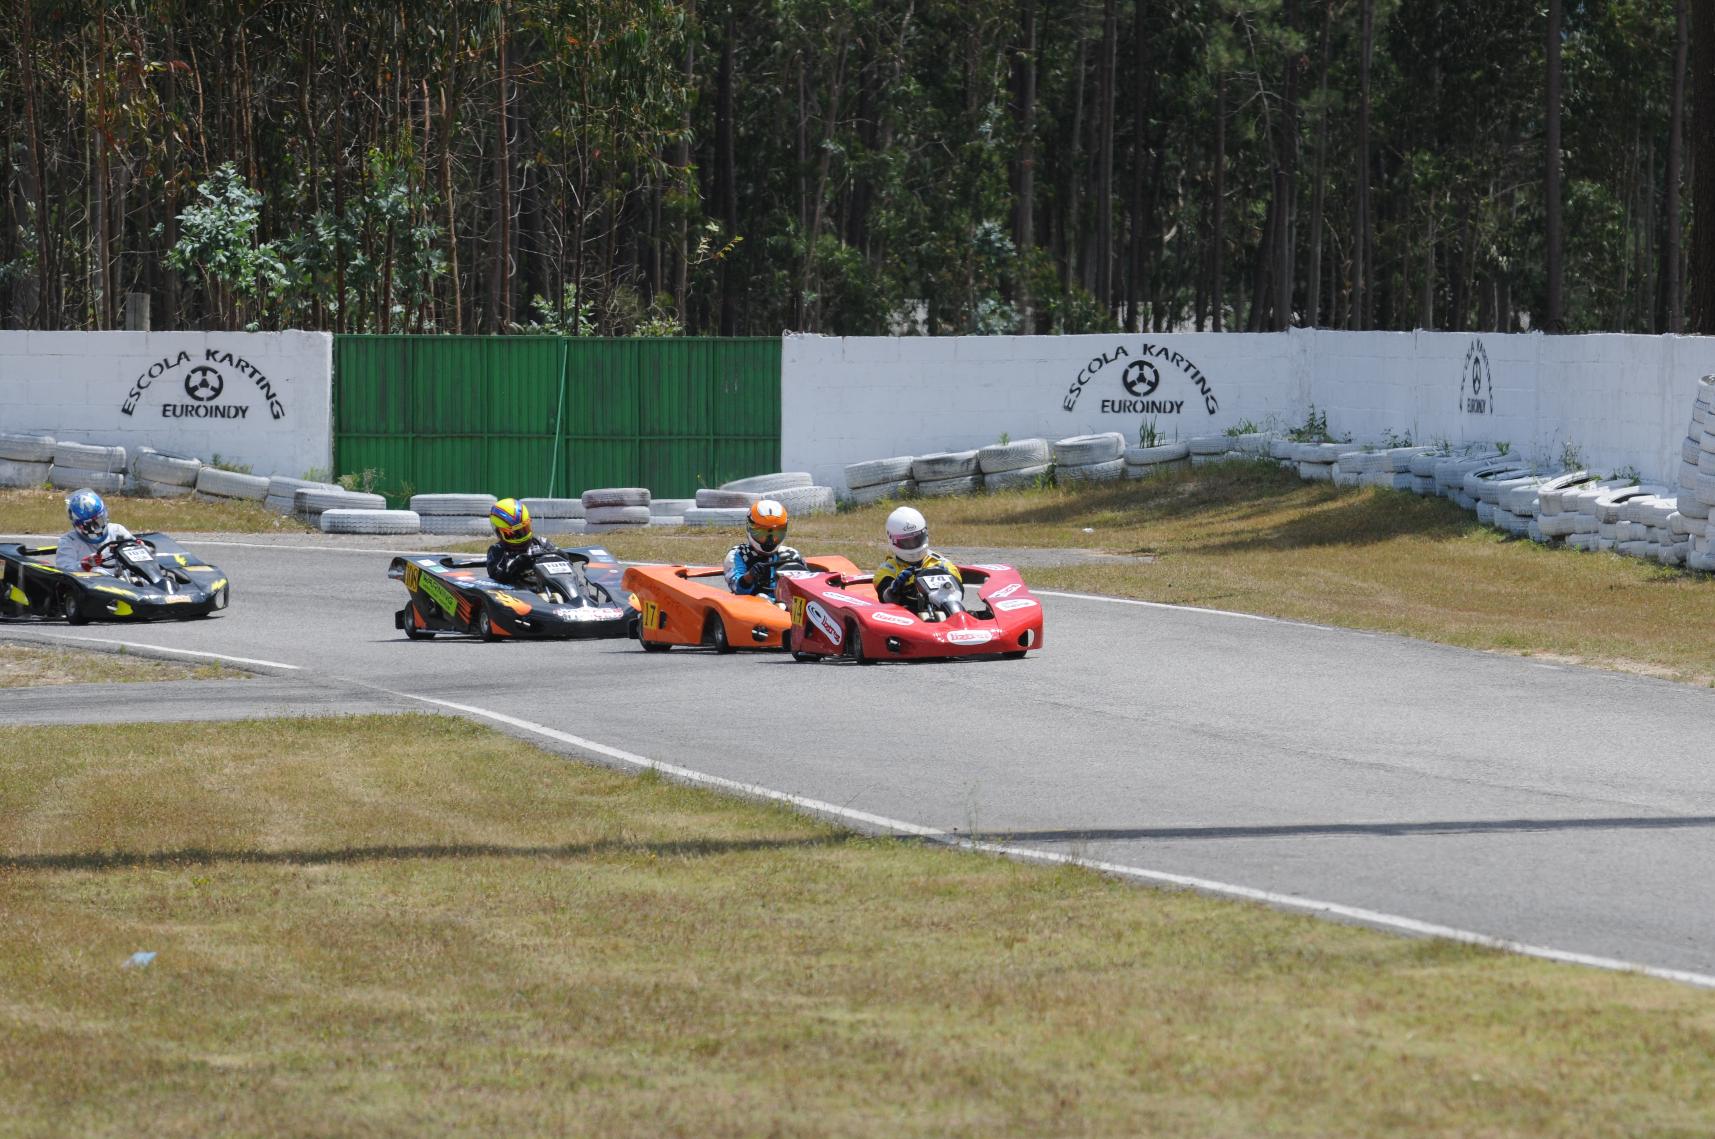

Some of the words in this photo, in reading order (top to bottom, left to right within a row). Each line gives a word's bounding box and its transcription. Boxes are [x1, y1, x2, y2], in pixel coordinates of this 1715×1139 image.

[121, 351, 191, 416] ESCOLA
[206, 349, 285, 420] KARTING
[1063, 346, 1129, 412] ESCOLA
[1143, 343, 1220, 415] KARTING
[162, 403, 249, 419] EUROINDY
[1101, 399, 1185, 414] EUROINDY
[645, 602, 656, 626] 17
